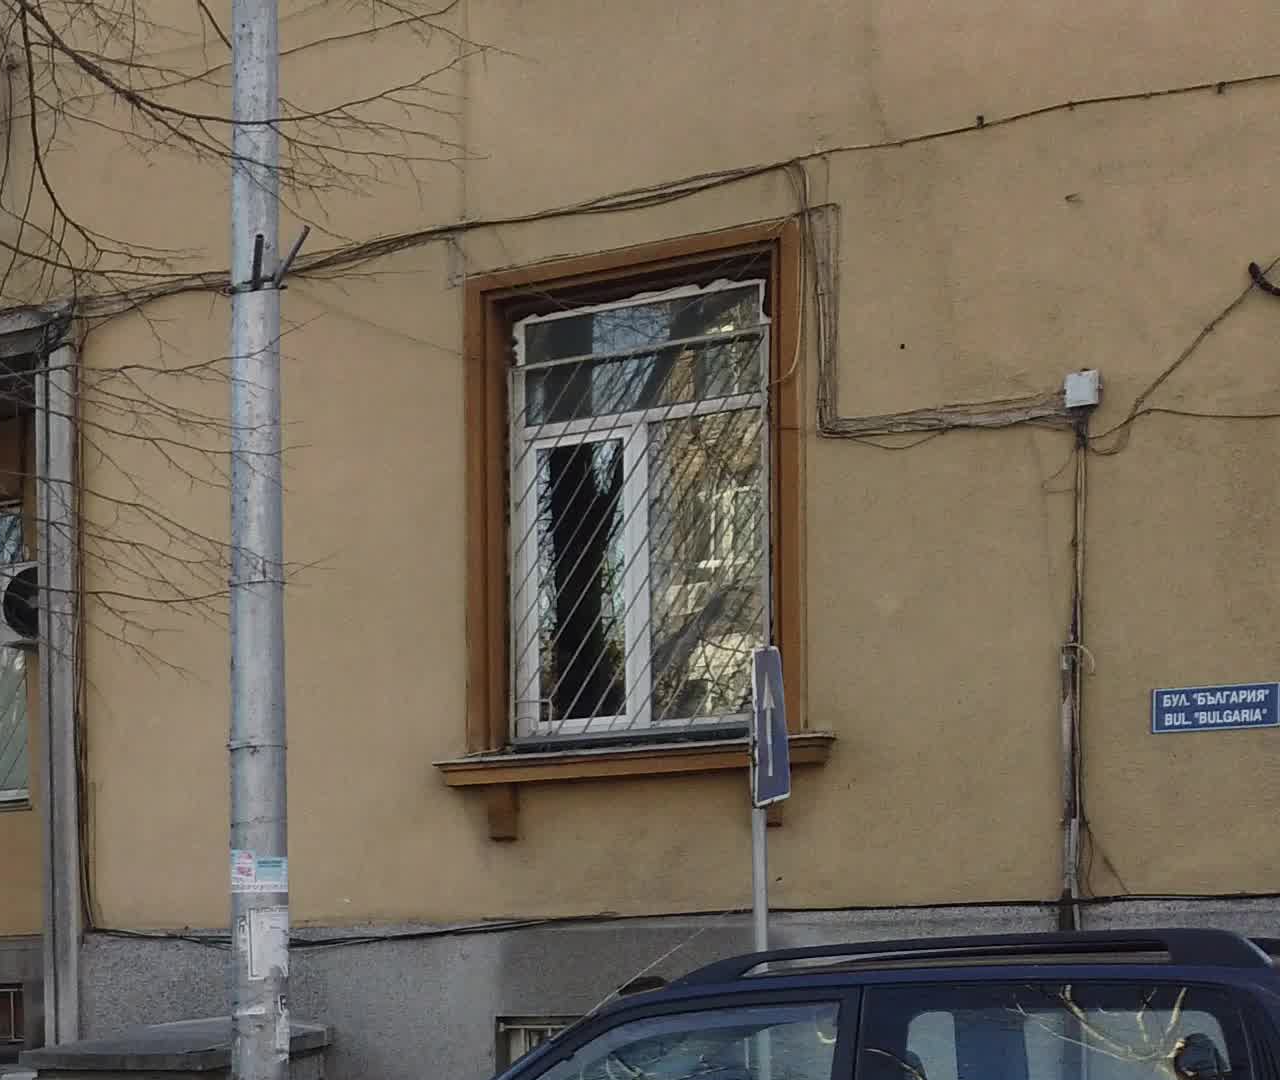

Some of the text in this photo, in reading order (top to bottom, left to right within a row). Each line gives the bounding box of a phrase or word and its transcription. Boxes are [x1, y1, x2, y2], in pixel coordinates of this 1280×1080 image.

[1162, 694, 1191, 707] БУЛ.
[1164, 708, 1268, 726] BUL. "BULGARIA"
